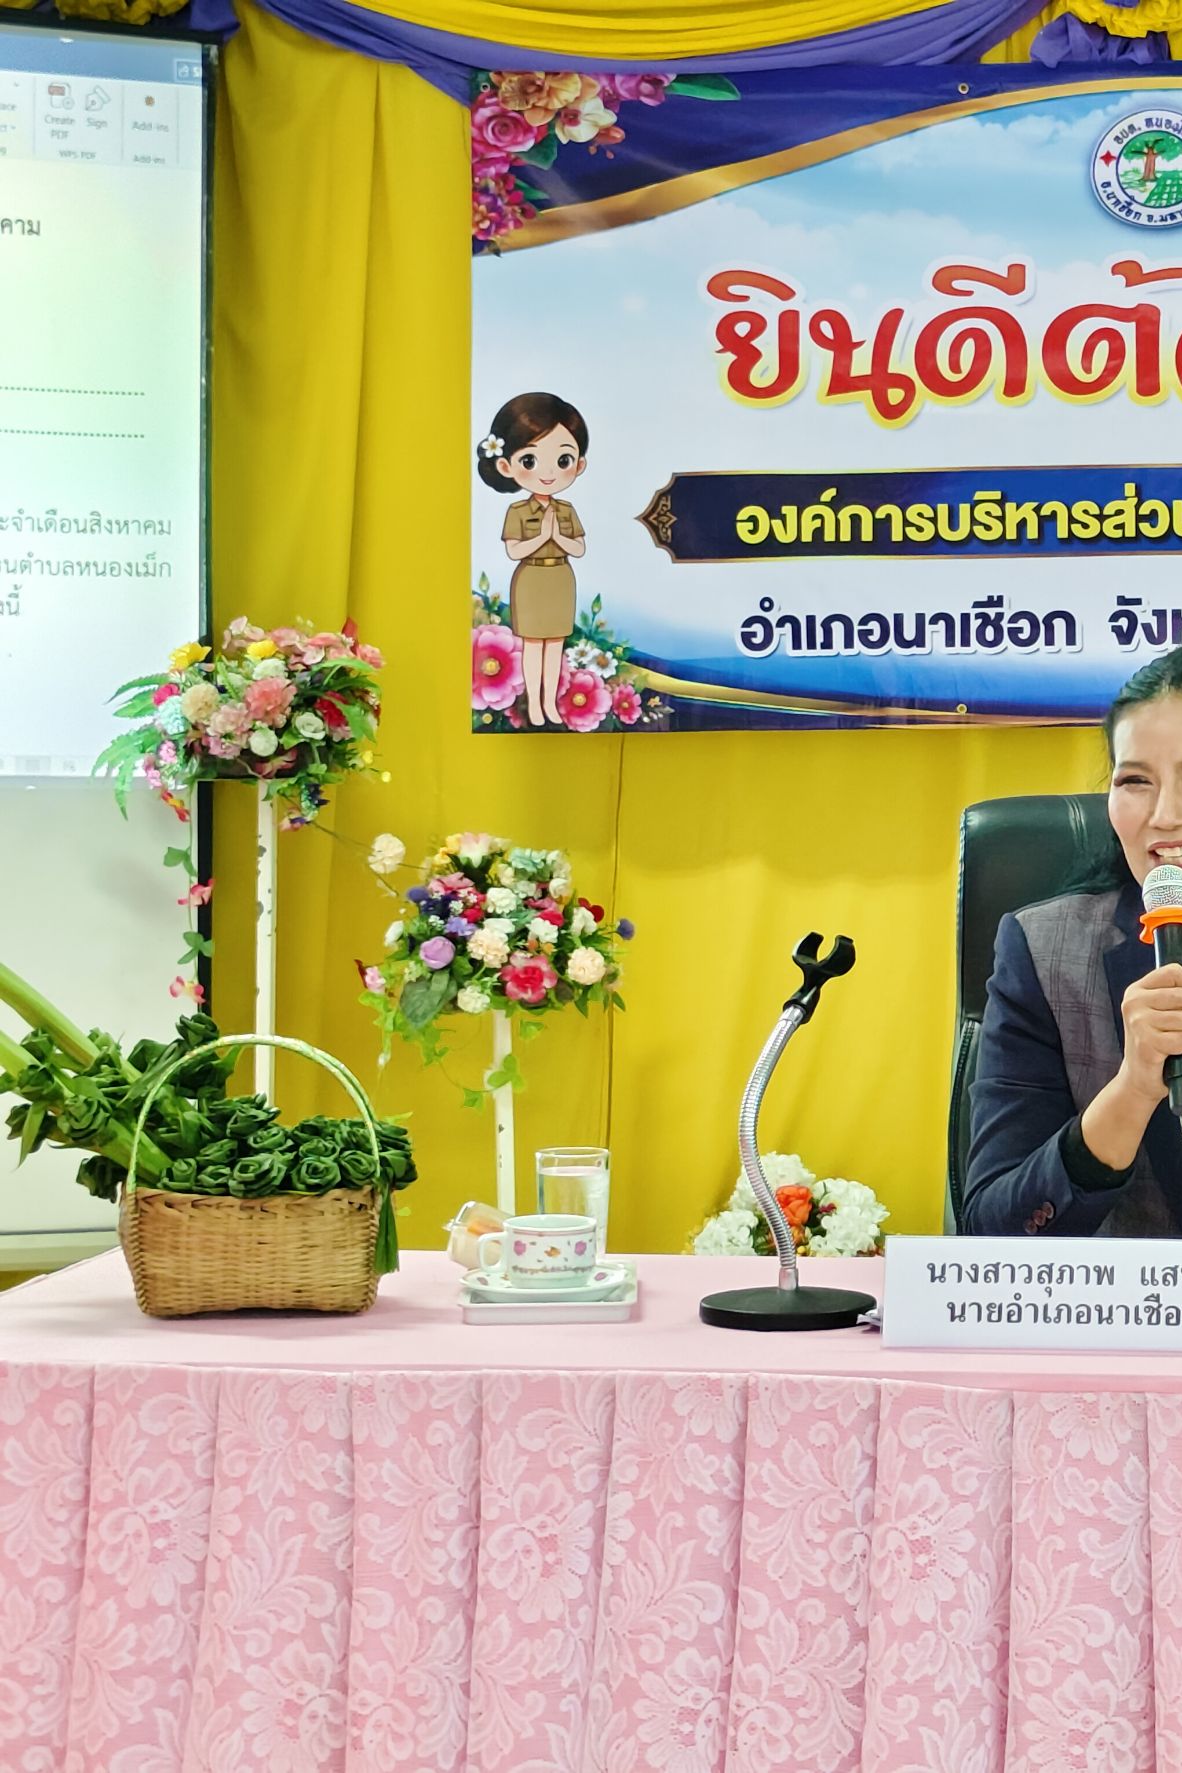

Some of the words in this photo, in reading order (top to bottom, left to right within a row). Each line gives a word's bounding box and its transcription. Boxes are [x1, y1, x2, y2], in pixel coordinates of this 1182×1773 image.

[0, 218, 41, 236] คาม
[0, 551, 171, 577] นตำบลหนองเม็ก
[740, 595, 1076, 652] อำเภอนาเชือก
[927, 1261, 1116, 1298] นางสาวสุภาพ
